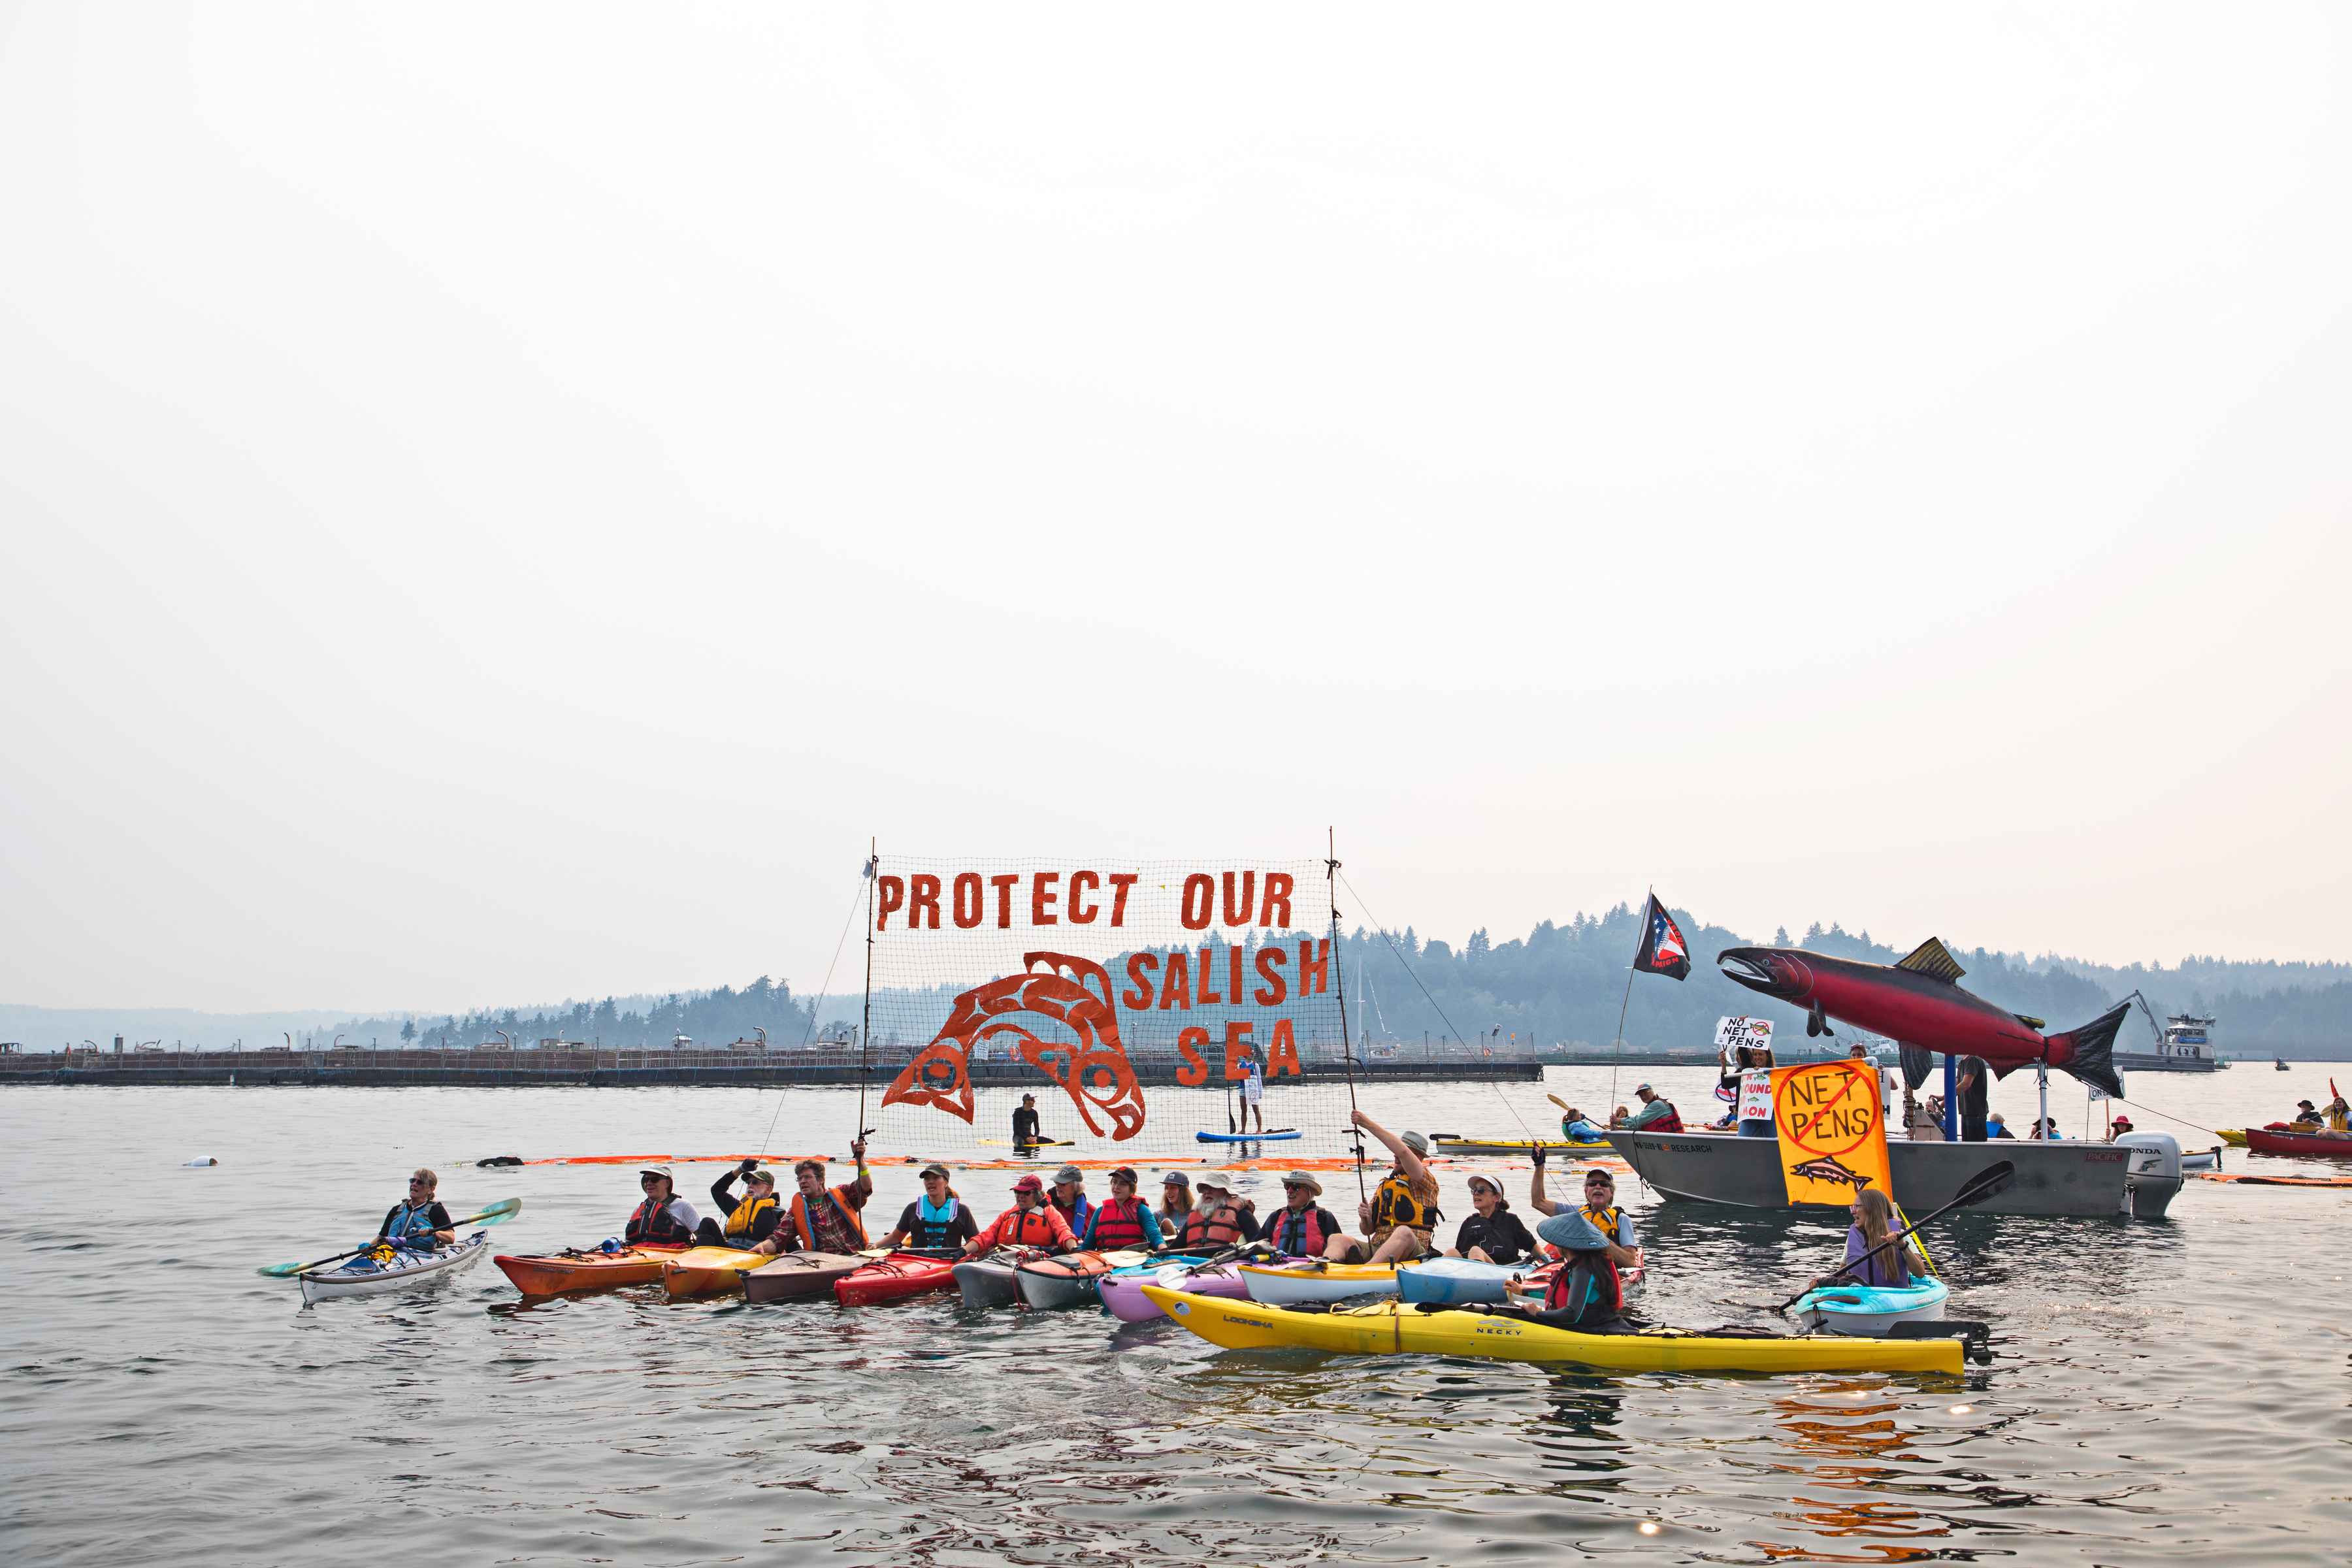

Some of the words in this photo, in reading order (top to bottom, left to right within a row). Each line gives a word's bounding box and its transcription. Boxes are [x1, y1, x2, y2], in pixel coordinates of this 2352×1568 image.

[877, 870, 1138, 931] PROTECT
[1181, 870, 1294, 931] OUR
[1123, 939, 1330, 1010] SALISH
[1723, 1026, 1749, 1036] NET
[1728, 1018, 1744, 1026] NO
[1176, 1019, 1301, 1086] SEA
[1727, 1036, 1765, 1048] PENS
[1743, 1084, 1771, 1094] OUND
[1789, 1070, 1854, 1107] NET
[1791, 1108, 1869, 1139] PENS
[2087, 1152, 2122, 1161] PACIFIC
